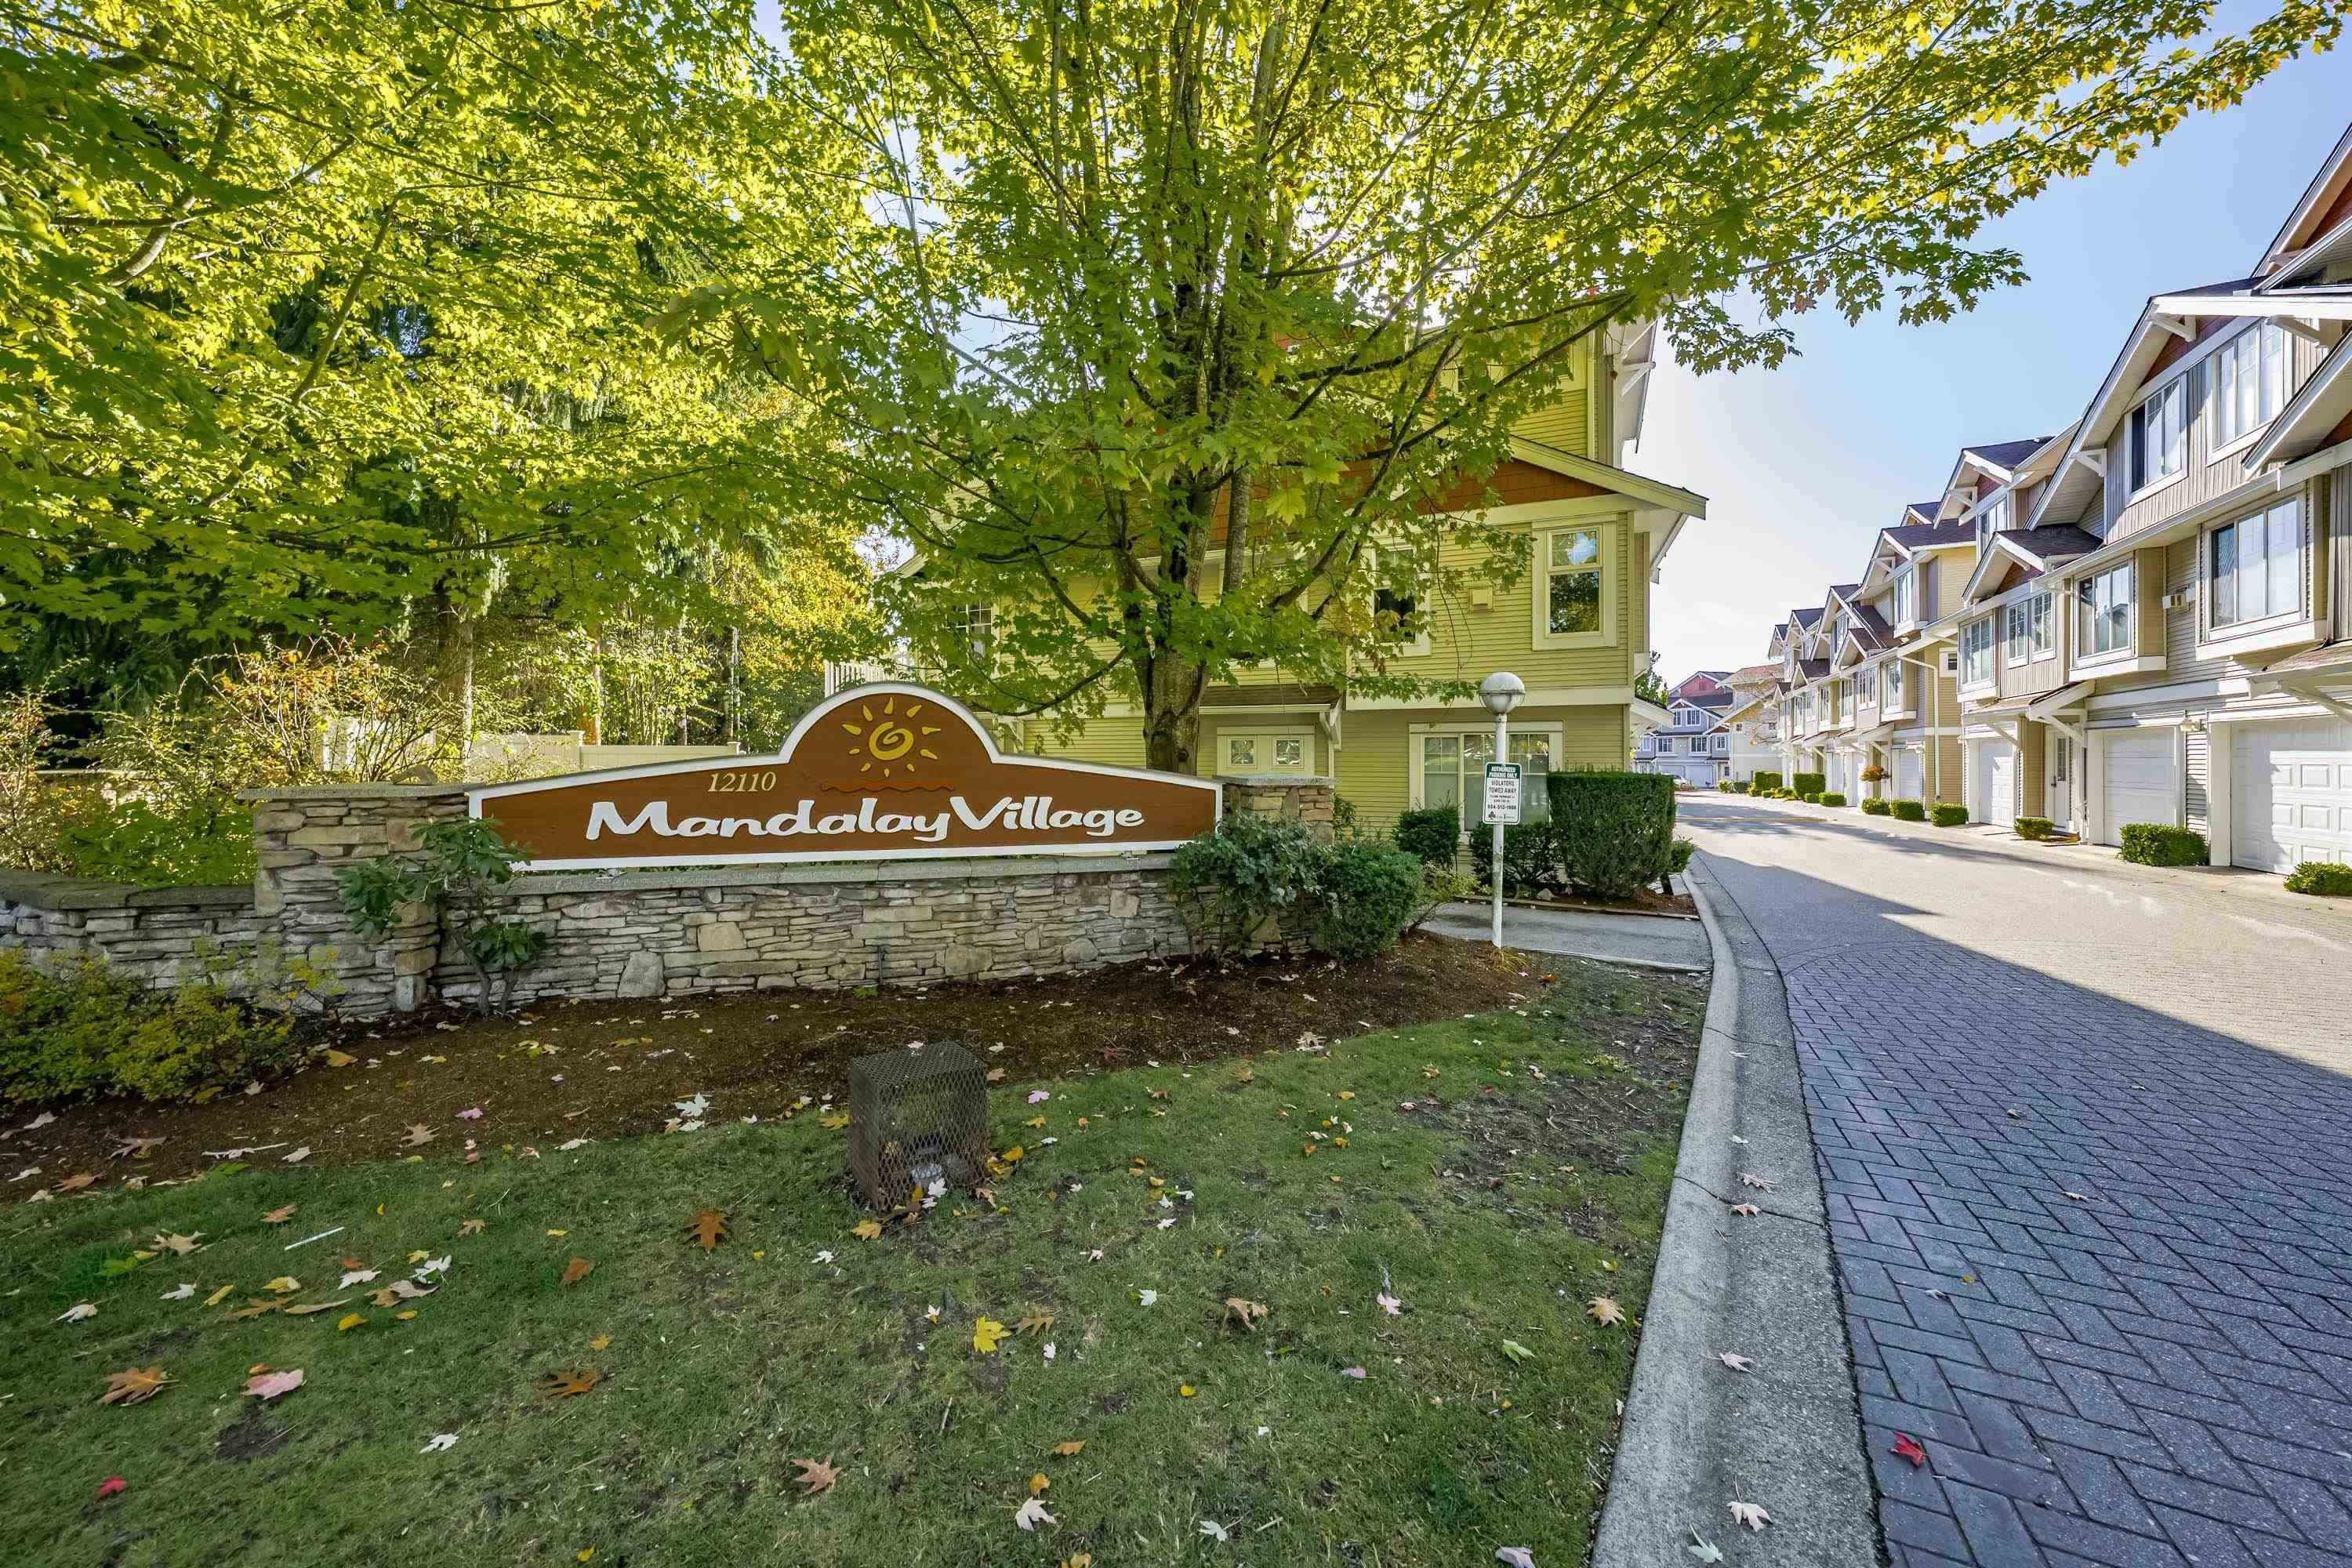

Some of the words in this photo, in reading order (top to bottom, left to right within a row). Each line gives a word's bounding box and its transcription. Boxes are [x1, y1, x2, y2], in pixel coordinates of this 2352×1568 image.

[707, 771, 777, 793] 12110
[586, 797, 951, 843] Mandalay
[949, 796, 1145, 837] Village
